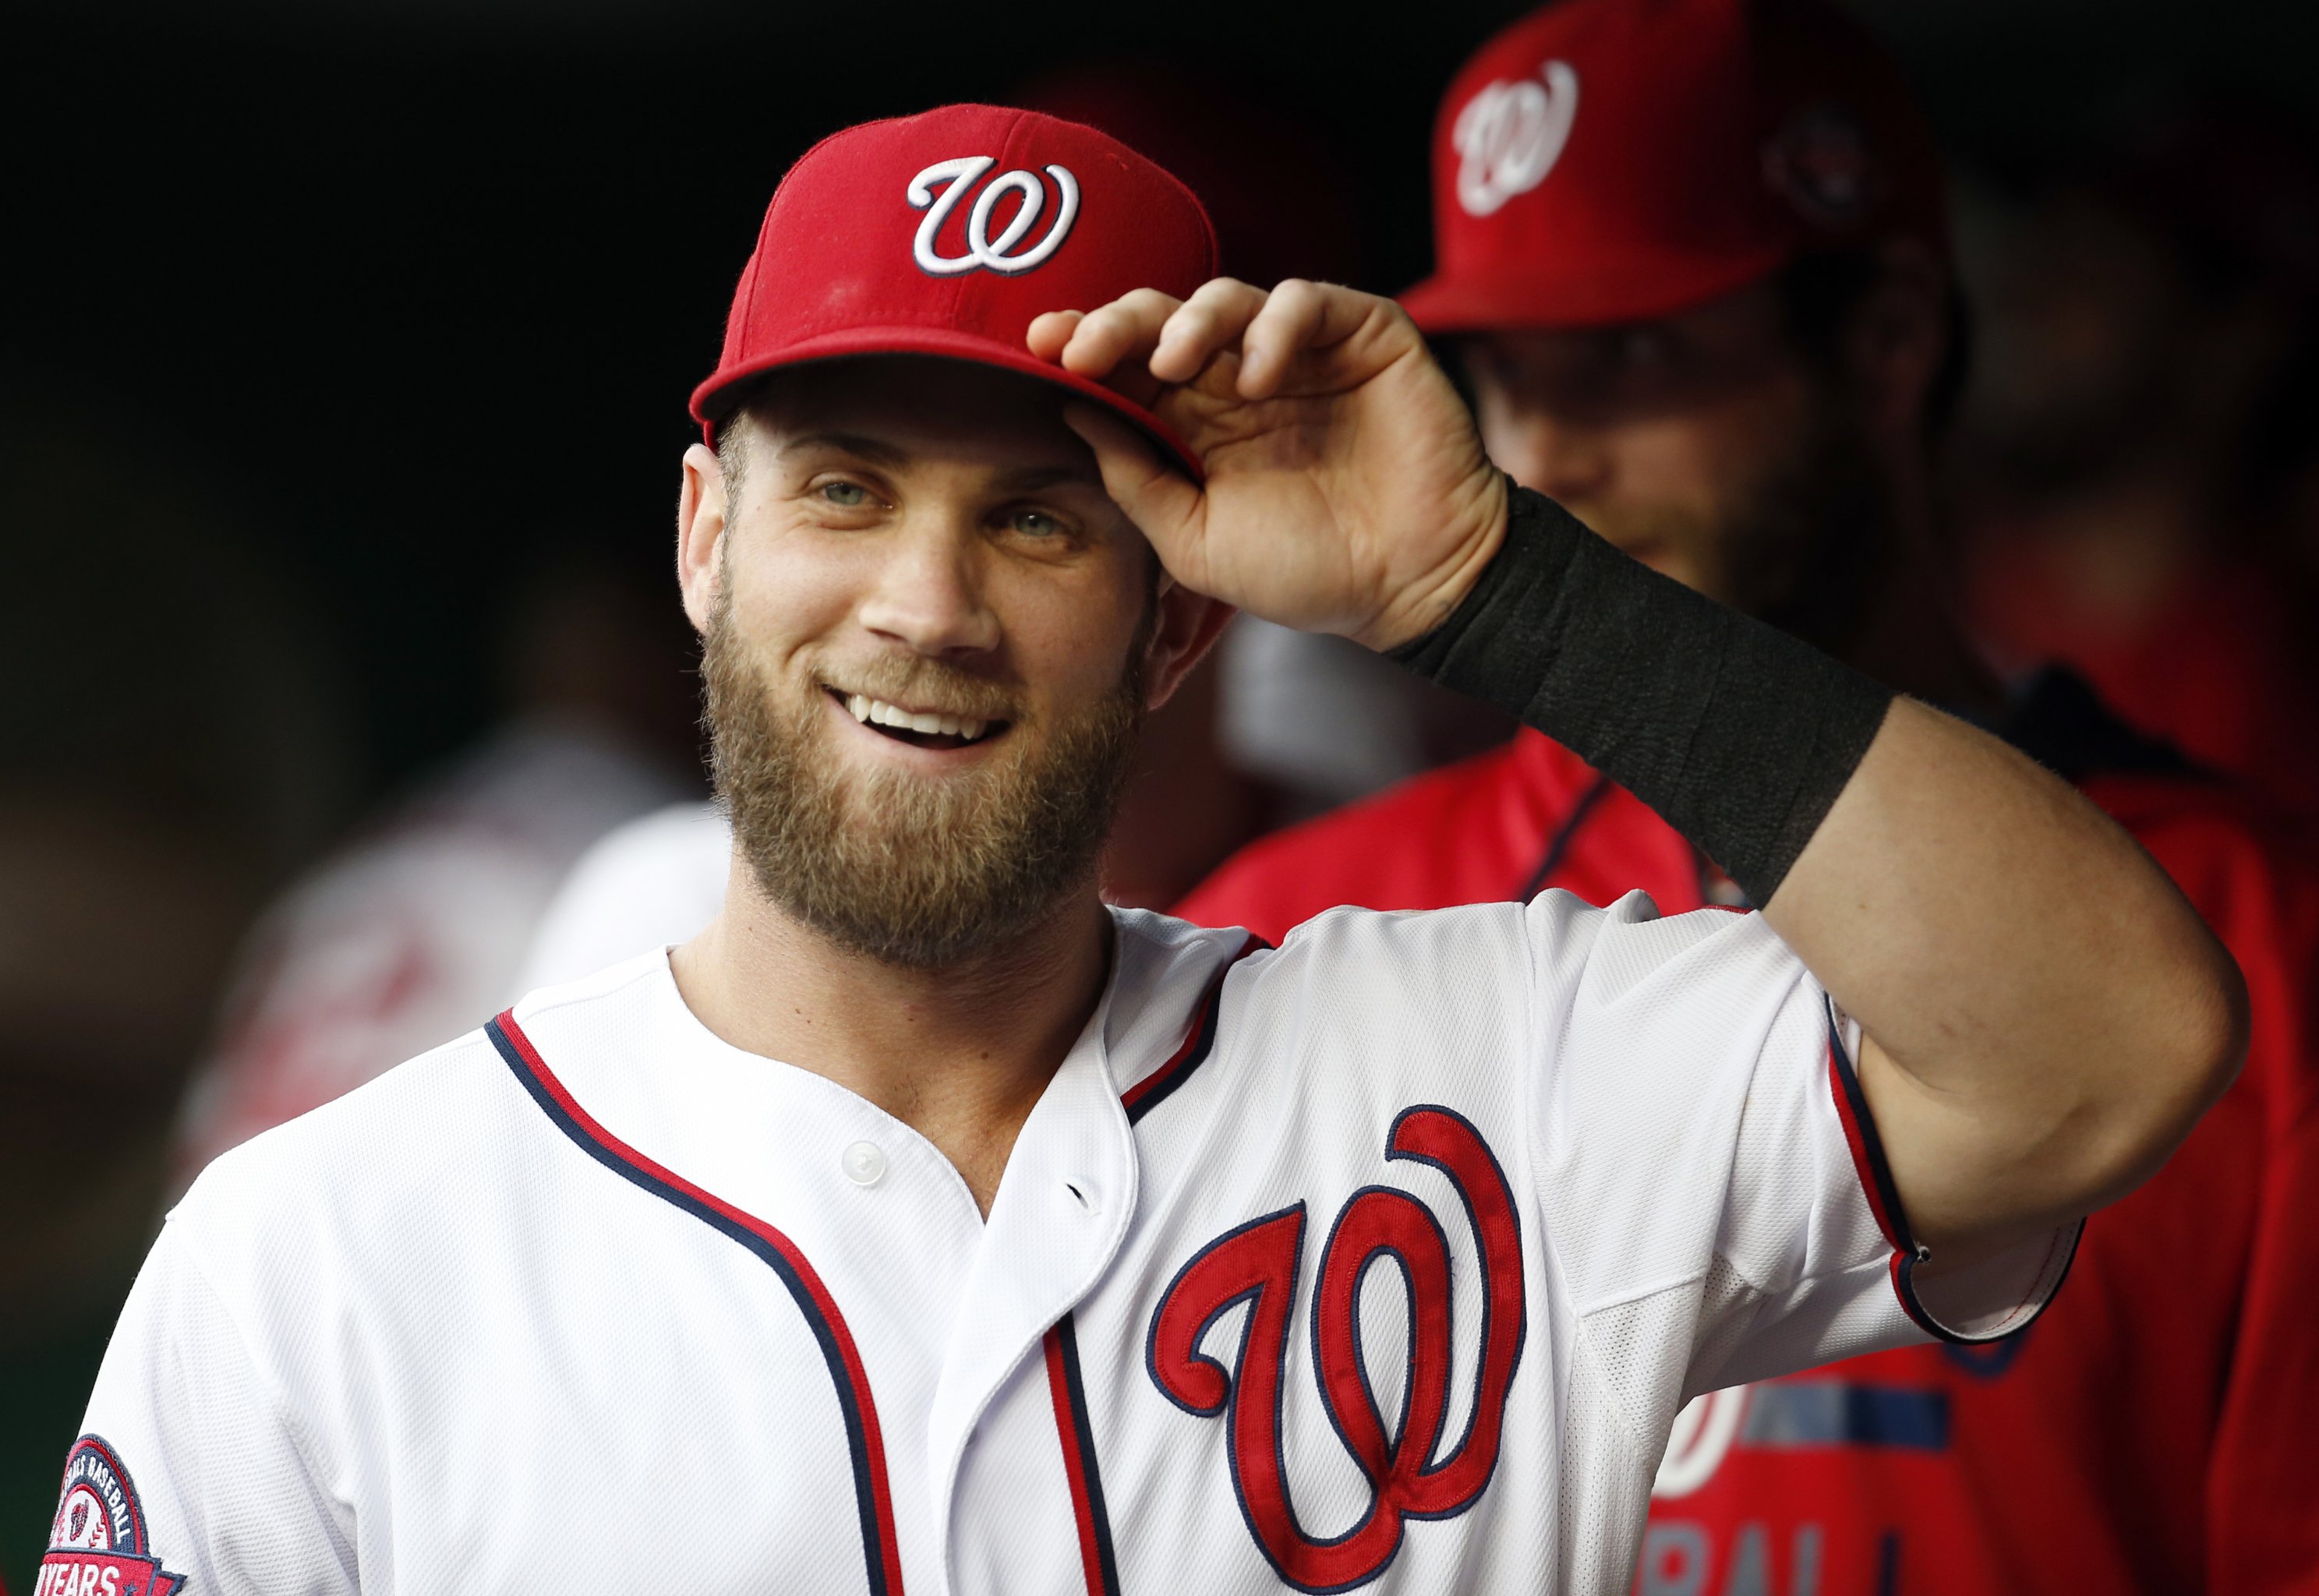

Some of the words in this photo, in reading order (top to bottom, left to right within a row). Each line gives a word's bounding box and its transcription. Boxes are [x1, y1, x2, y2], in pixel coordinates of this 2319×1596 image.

[907, 155, 1082, 277] W
[1145, 1103, 1528, 1595] W
[87, 1456, 131, 1545] BASEBALL
